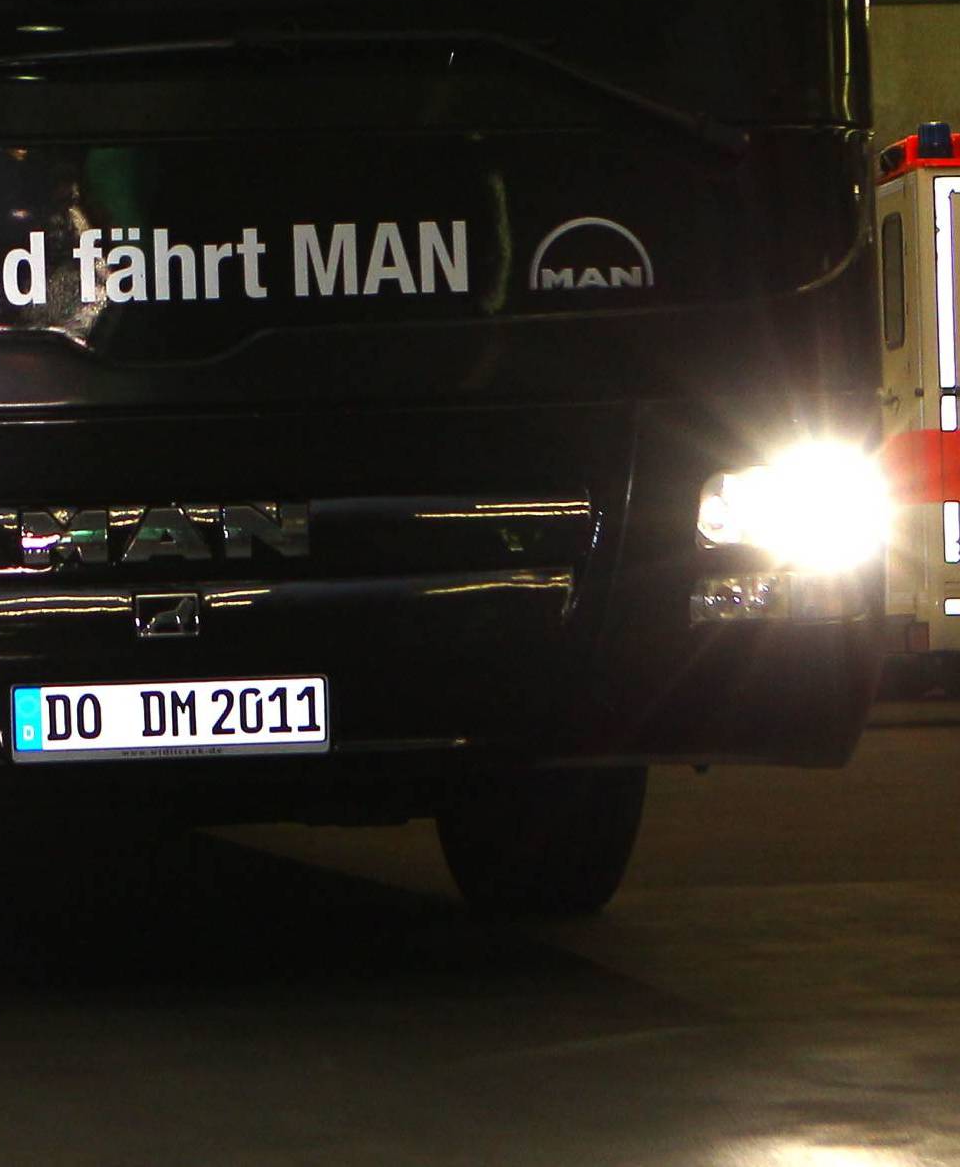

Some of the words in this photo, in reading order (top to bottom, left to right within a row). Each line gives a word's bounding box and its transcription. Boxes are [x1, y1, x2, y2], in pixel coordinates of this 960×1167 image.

[71, 226, 268, 304] fährt
[291, 219, 470, 298] MAN
[540, 264, 644, 290] MAN
[20, 504, 310, 563] MAN
[45, 693, 102, 741] DO
[140, 690, 197, 737] DM
[211, 686, 321, 735] 2011
